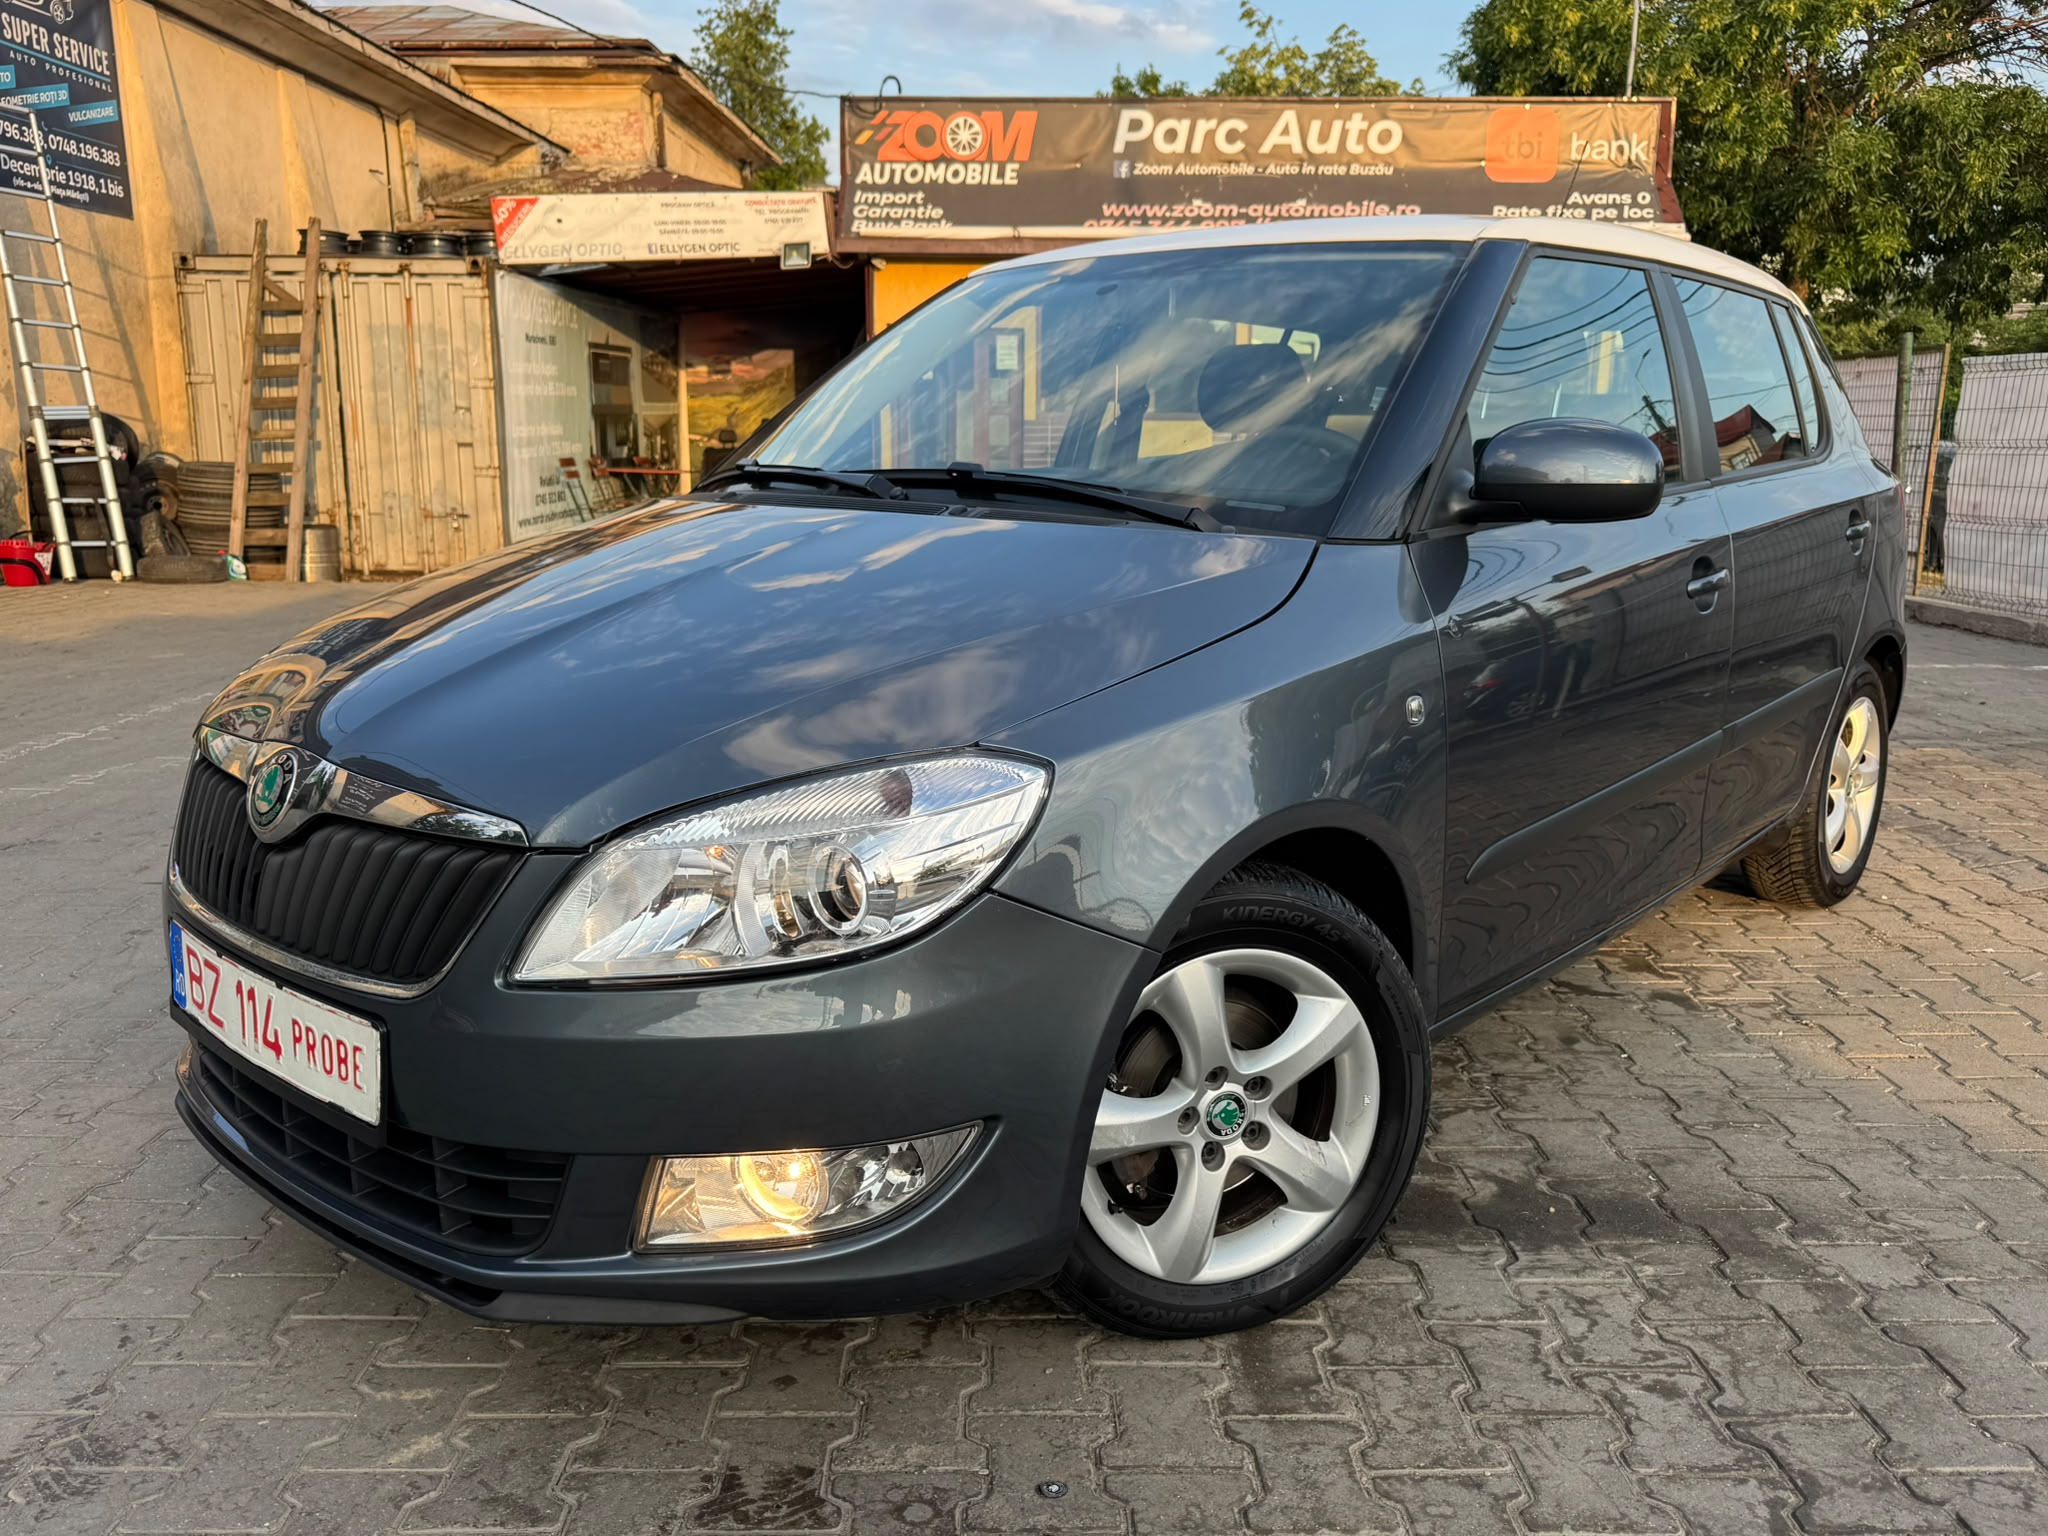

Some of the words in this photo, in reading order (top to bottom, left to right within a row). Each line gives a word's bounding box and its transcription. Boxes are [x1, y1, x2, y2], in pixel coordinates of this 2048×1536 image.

[1, 12, 50, 54] SUPER
[53, 32, 110, 75] SERVICE
[9, 51, 36, 66] AUTO
[45, 63, 112, 93] PROFESIONAL
[0, 93, 39, 106] EOMETRIE
[68, 105, 115, 122] VULCANIZARE
[872, 110, 1038, 162] ZOOM
[1113, 109, 1248, 154] Parc
[1258, 109, 1403, 155] Auto
[48, 134, 121, 167] 0748.196.383
[1502, 132, 1543, 160] tbi
[1570, 132, 1649, 162] bank
[855, 163, 1020, 185] AUTOMOBILE
[1133, 163, 1173, 175] Zoom
[1175, 162, 1254, 176] Automobile
[1266, 163, 1300, 175] Auto
[1318, 163, 1348, 175] rate
[67, 170, 99, 194] 1918,
[99, 178, 107, 193] 1
[107, 178, 124, 197] bis
[854, 190, 925, 206] Import
[1102, 200, 1421, 217] www.zoom-automobile.ro
[1566, 191, 1632, 205] Avans
[852, 203, 944, 219] Garantie
[1492, 205, 1542, 218] Rate
[1545, 205, 1587, 219] fixe
[1591, 207, 1618, 221] pe
[1623, 205, 1655, 219] loc
[576, 241, 623, 257] OPTIC
[660, 241, 707, 255] ELLYGEN
[708, 240, 742, 253] OPTIC
[1222, 905, 1316, 928] KINERGY
[175, 969, 185, 997] RO
[186, 944, 225, 1029] BZ
[236, 979, 282, 1061] 114
[291, 1017, 367, 1093] PROBE
